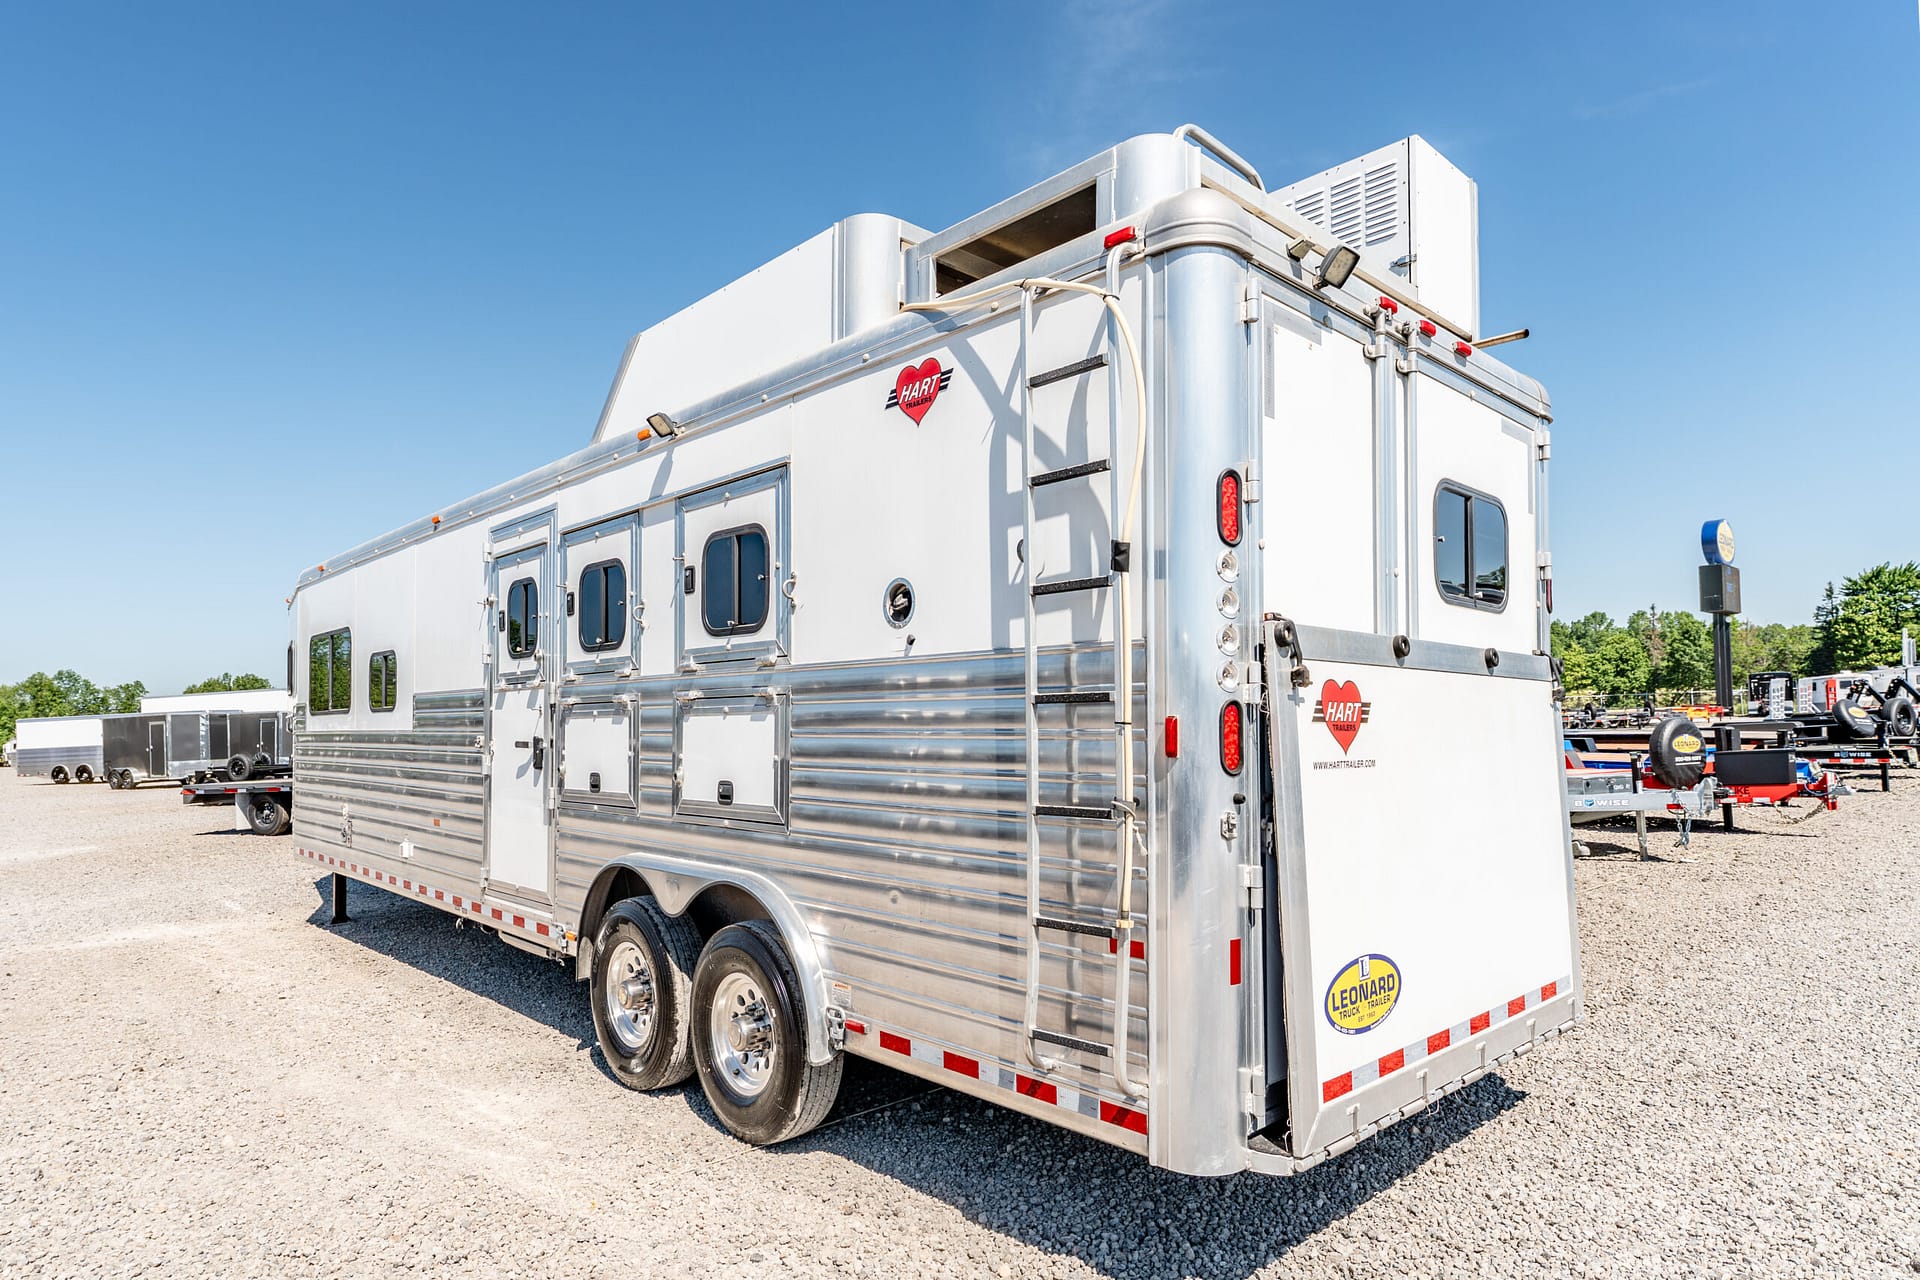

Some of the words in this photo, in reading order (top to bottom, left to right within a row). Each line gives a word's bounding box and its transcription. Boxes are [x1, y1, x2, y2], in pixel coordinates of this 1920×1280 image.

[898, 373, 942, 404] HART
[905, 395, 933, 410] TRAILERS
[1325, 701, 1362, 722] HART
[1332, 723, 1356, 732] TRAILERS
[1313, 759, 1376, 770] WWW.HARTTRAILER.COM
[1331, 973, 1395, 1012] LEONARD
[1339, 1005, 1361, 1020] TRUCK
[1367, 994, 1391, 1010] TRAILER
